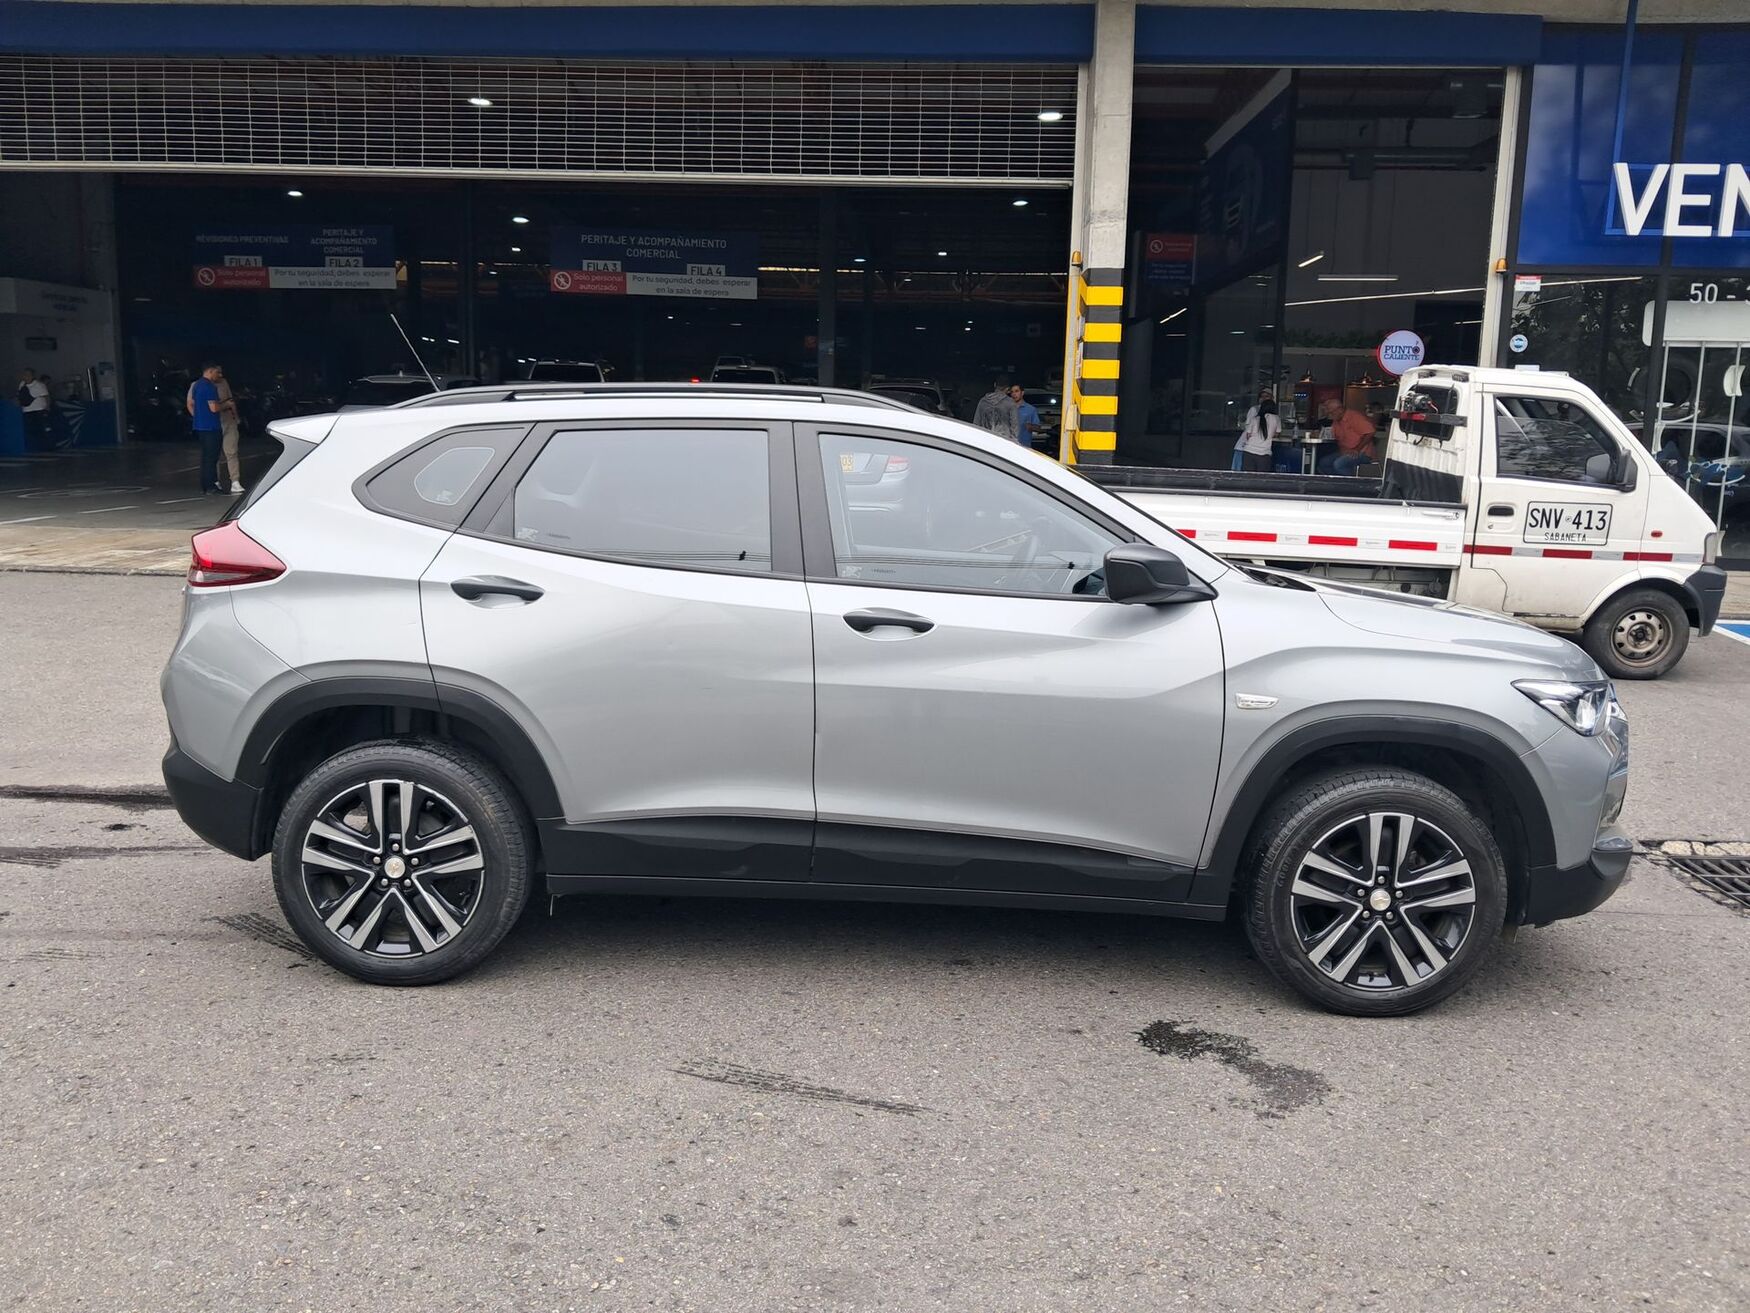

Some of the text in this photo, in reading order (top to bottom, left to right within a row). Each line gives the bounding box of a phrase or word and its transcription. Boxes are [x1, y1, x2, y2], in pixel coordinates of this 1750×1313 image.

[1613, 162, 1750, 238] VEN
[580, 234, 728, 249] PERITAJE Y ACOMPAÑAMIENTO
[324, 246, 364, 254] COMERCIAL
[626, 248, 682, 260] COMERCIAL
[229, 257, 254, 267] FILA
[329, 259, 360, 268] FILA 2
[587, 262, 618, 272] FILA 3
[690, 266, 722, 276] FILA 4
[591, 274, 624, 284] personal
[632, 274, 645, 282] Por
[646, 275, 656, 283] tu
[722, 280, 752, 289] esperar
[579, 282, 618, 292] autorizado
[692, 287, 702, 295] de
[703, 289, 729, 298] espera
[1690, 282, 1718, 304] 50
[1384, 344, 1421, 354] PUNTO
[1383, 353, 1420, 361] CALIENTE
[1529, 508, 1608, 531] SNV 413
[1544, 532, 1588, 542] SABANETA
